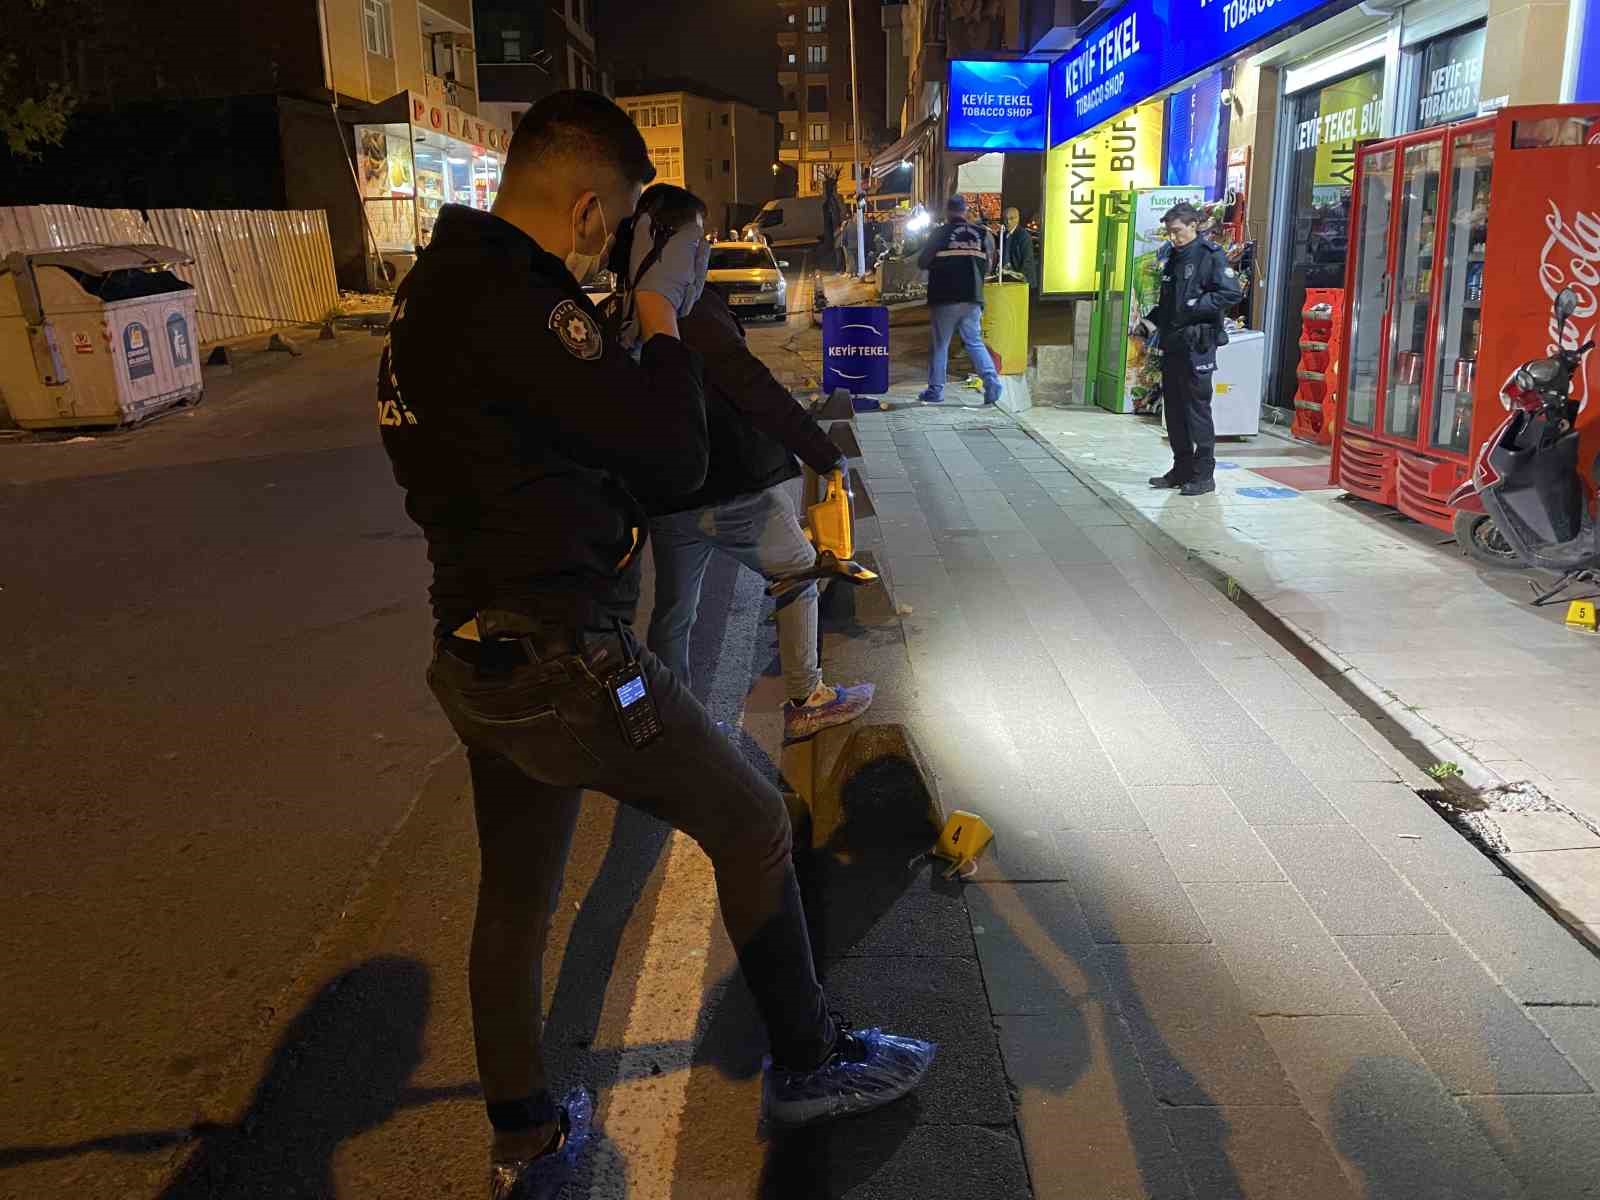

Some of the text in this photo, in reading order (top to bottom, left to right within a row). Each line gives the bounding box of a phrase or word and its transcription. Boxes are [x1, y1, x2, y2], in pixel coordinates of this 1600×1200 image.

[1223, 0, 1282, 33] TOBA
[1065, 12, 1140, 99] KEYİF TEKEL
[961, 92, 1033, 106] KEYİF TEKEL
[1075, 71, 1125, 119] TOBACCO SHOP
[1420, 86, 1471, 121] TOBACCO
[962, 106, 1033, 118] TOBACCO SHOP
[1324, 107, 1358, 144] TEKEL
[1065, 143, 1096, 224] KEYİF
[828, 343, 889, 357] KEYİF TEKEL
[1579, 607, 1585, 618] 5
[951, 825, 962, 845] 4
